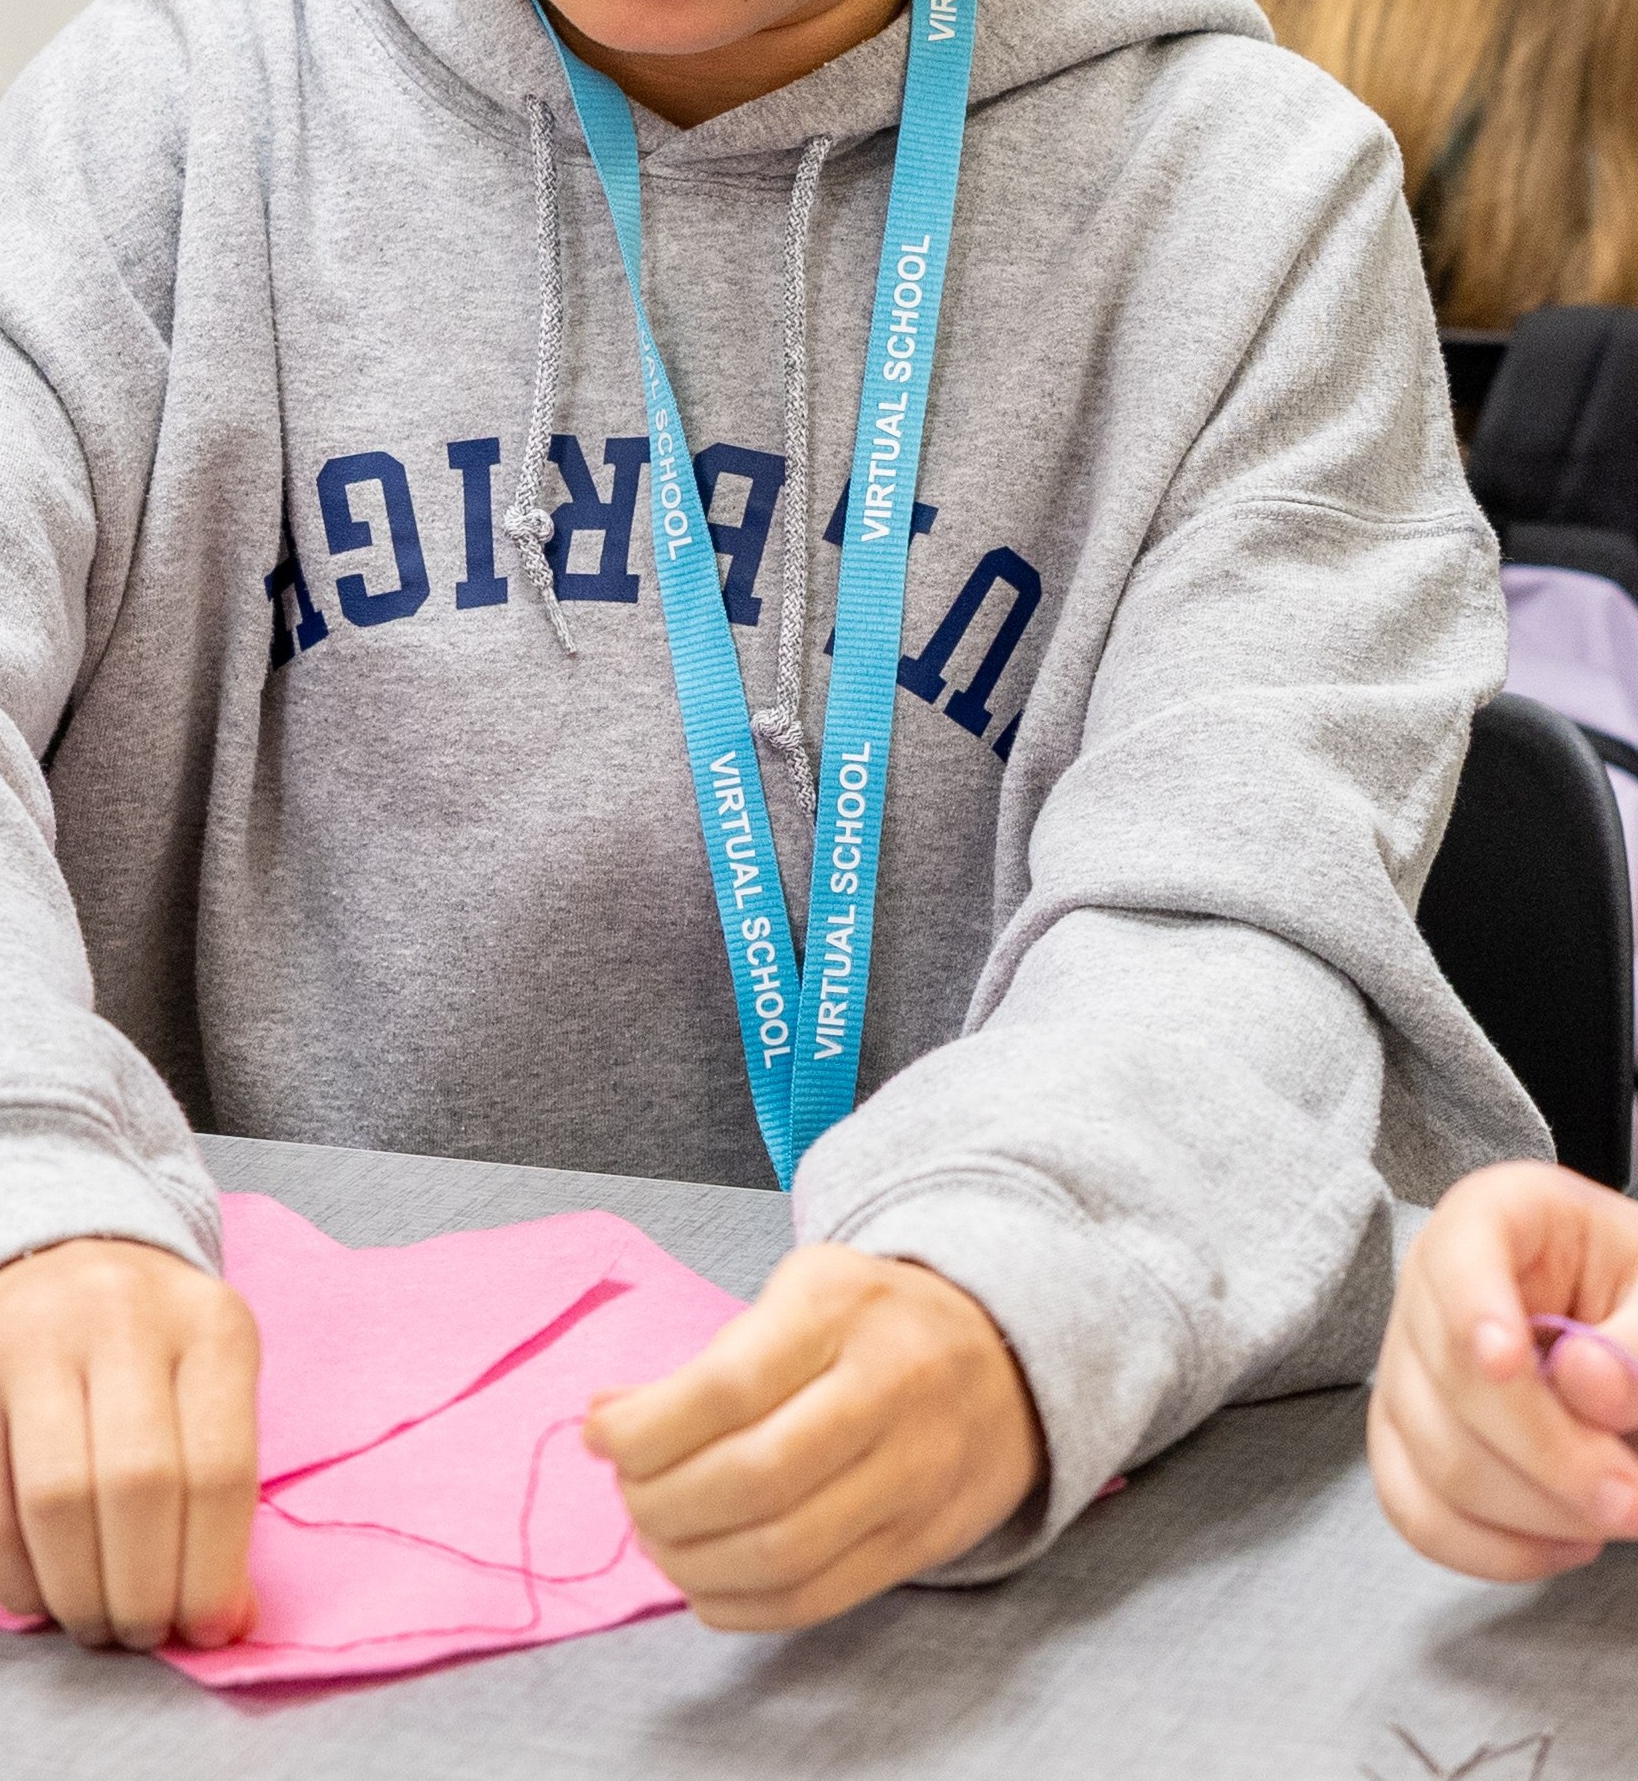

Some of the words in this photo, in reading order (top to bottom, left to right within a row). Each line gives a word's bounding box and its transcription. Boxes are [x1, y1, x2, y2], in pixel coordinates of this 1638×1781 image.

[883, 234, 931, 383] SCHOOL
[655, 408, 693, 561] SCHOOL
[860, 392, 908, 542] VIRTUAL
[829, 742, 871, 896] SCHOOL
[709, 750, 763, 910] VIRTUAL
[741, 916, 792, 1070] SCHOOL
[813, 904, 856, 1061] VIRTUAL
